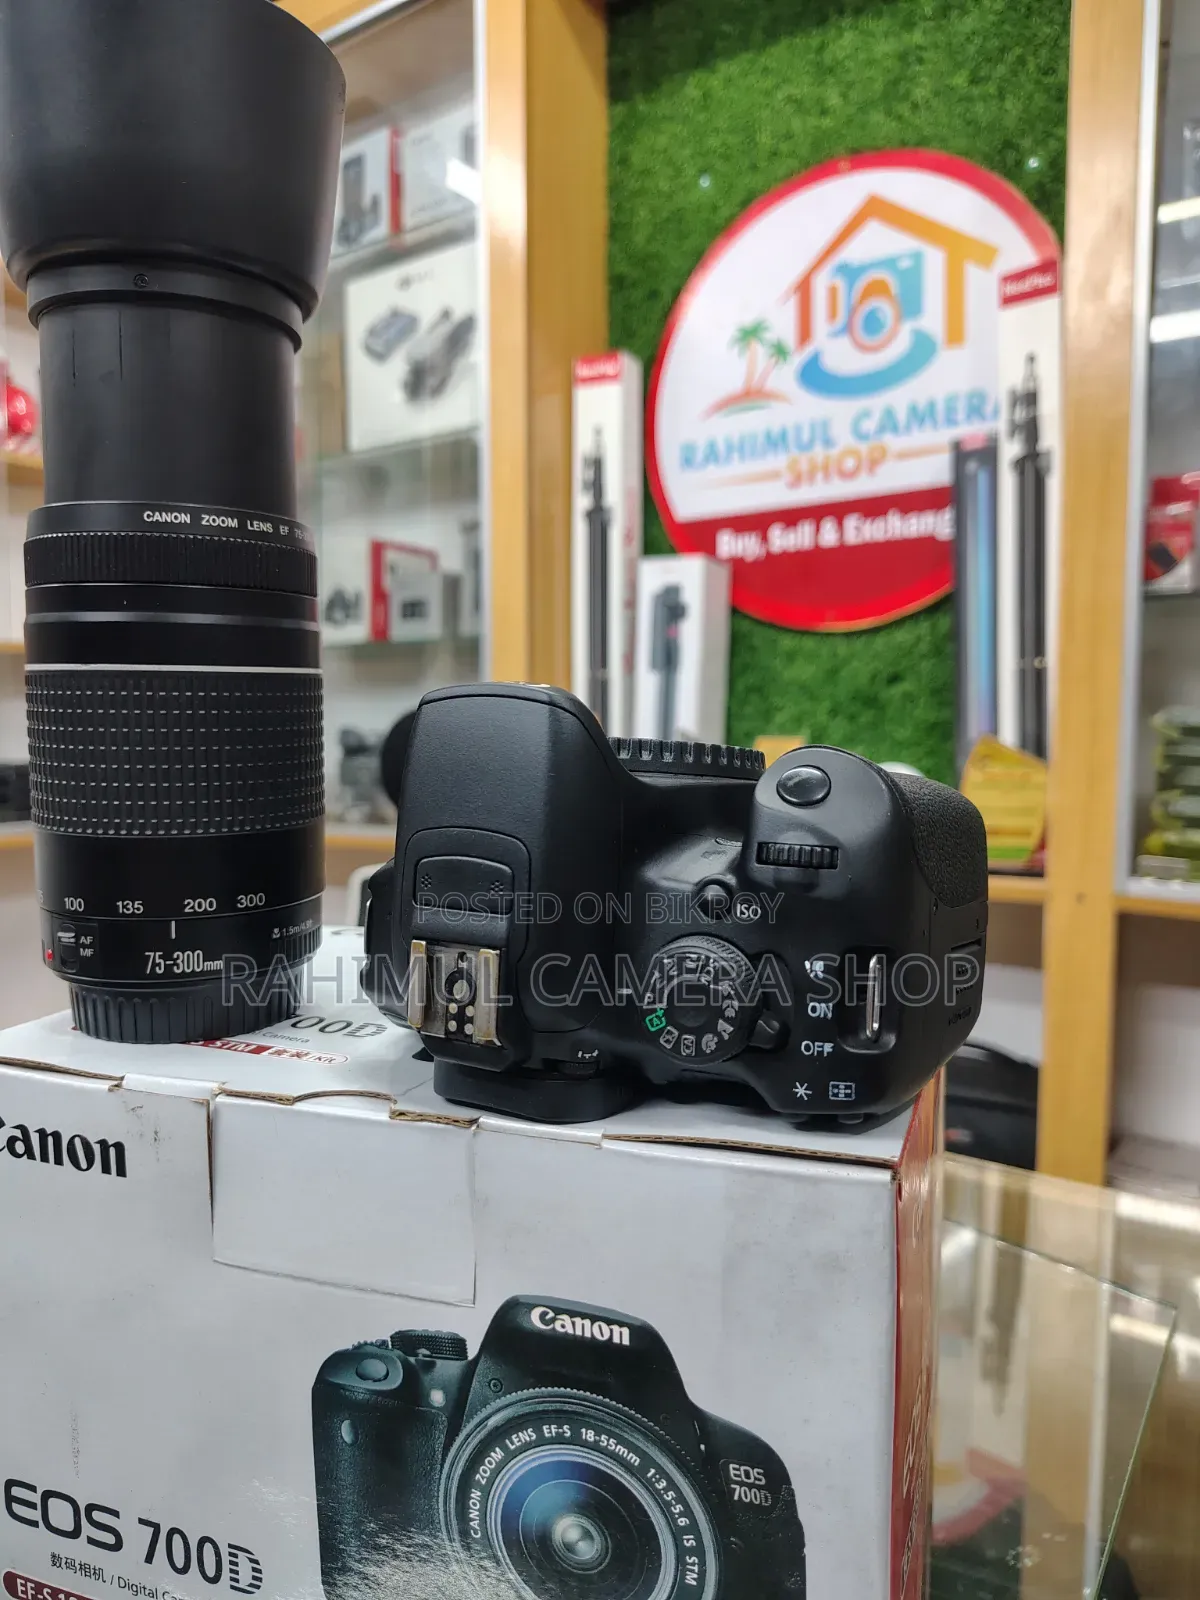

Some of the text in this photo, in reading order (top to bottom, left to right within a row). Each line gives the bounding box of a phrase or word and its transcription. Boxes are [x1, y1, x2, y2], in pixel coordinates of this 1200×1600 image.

[679, 420, 836, 472] RAHIMUL
[785, 441, 888, 490] SHOP
[143, 511, 191, 524] CANON
[201, 514, 238, 529] ZOOM
[247, 520, 274, 534] LENS
[279, 525, 290, 536] EF
[817, 514, 842, 548] &
[841, 505, 955, 546] Exchang
[64, 897, 85, 912] 100
[116, 900, 144, 914] 135
[184, 898, 217, 913] 200
[237, 893, 266, 908] 300
[736, 902, 762, 919] ISO
[80, 936, 93, 945] AF
[80, 948, 94, 957] MF
[145, 950, 223, 975] 75-300mm
[808, 1002, 832, 1018] ON
[290, 1013, 388, 1038] 00D
[801, 1040, 834, 1057] OFF
[530, 1306, 630, 1346] Canon
[729, 1464, 766, 1486] EOS
[468, 1425, 698, 1586] CANON ZOOM LENS EF-S 18-55mm 1:3.5-5.6 IS STM
[730, 1484, 772, 1506] 700D
[4, 1478, 264, 1595] EOS 700D
[50, 1551, 107, 1584] 数码相机
[117, 1576, 158, 1600] Digital
